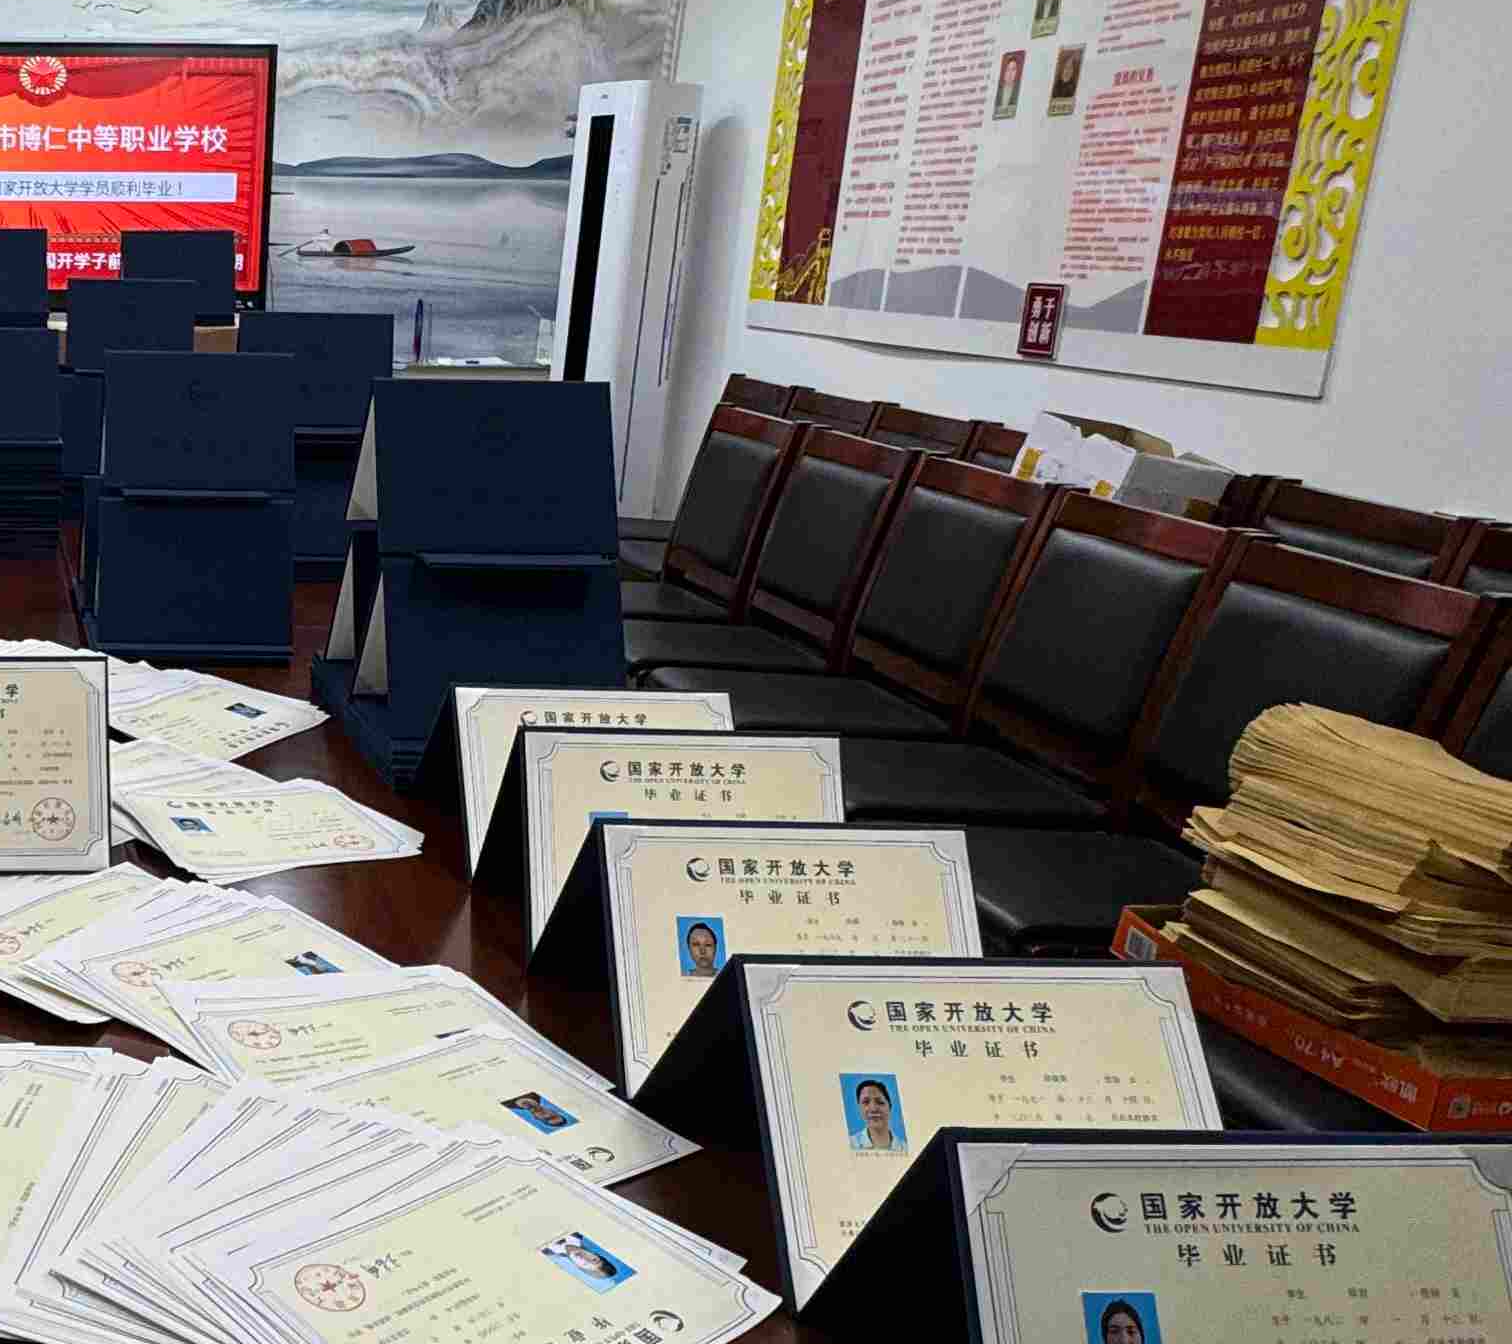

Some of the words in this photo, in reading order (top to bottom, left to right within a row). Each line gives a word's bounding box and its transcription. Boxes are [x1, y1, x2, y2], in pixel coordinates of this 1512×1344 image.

[544, 711, 648, 726] 国家开放大学
[626, 761, 746, 779] 国家开放大学
[643, 788, 734, 803] 毕业证书
[718, 858, 857, 879] 国家开放大学
[738, 889, 842, 906] 毕业证书
[885, 1001, 1054, 1024] 国家开放大学
[915, 1040, 1040, 1058] 毕业证书
[1140, 1192, 1357, 1221] 国家开放大学
[1144, 1223, 1171, 1235] THE
[1174, 1223, 1210, 1235] OPEN
[1212, 1223, 1292, 1235] UNIVERSITY
[1296, 1223, 1314, 1235] OF
[1317, 1223, 1361, 1235] CHINA
[1176, 1243, 1338, 1268] 毕业证书
